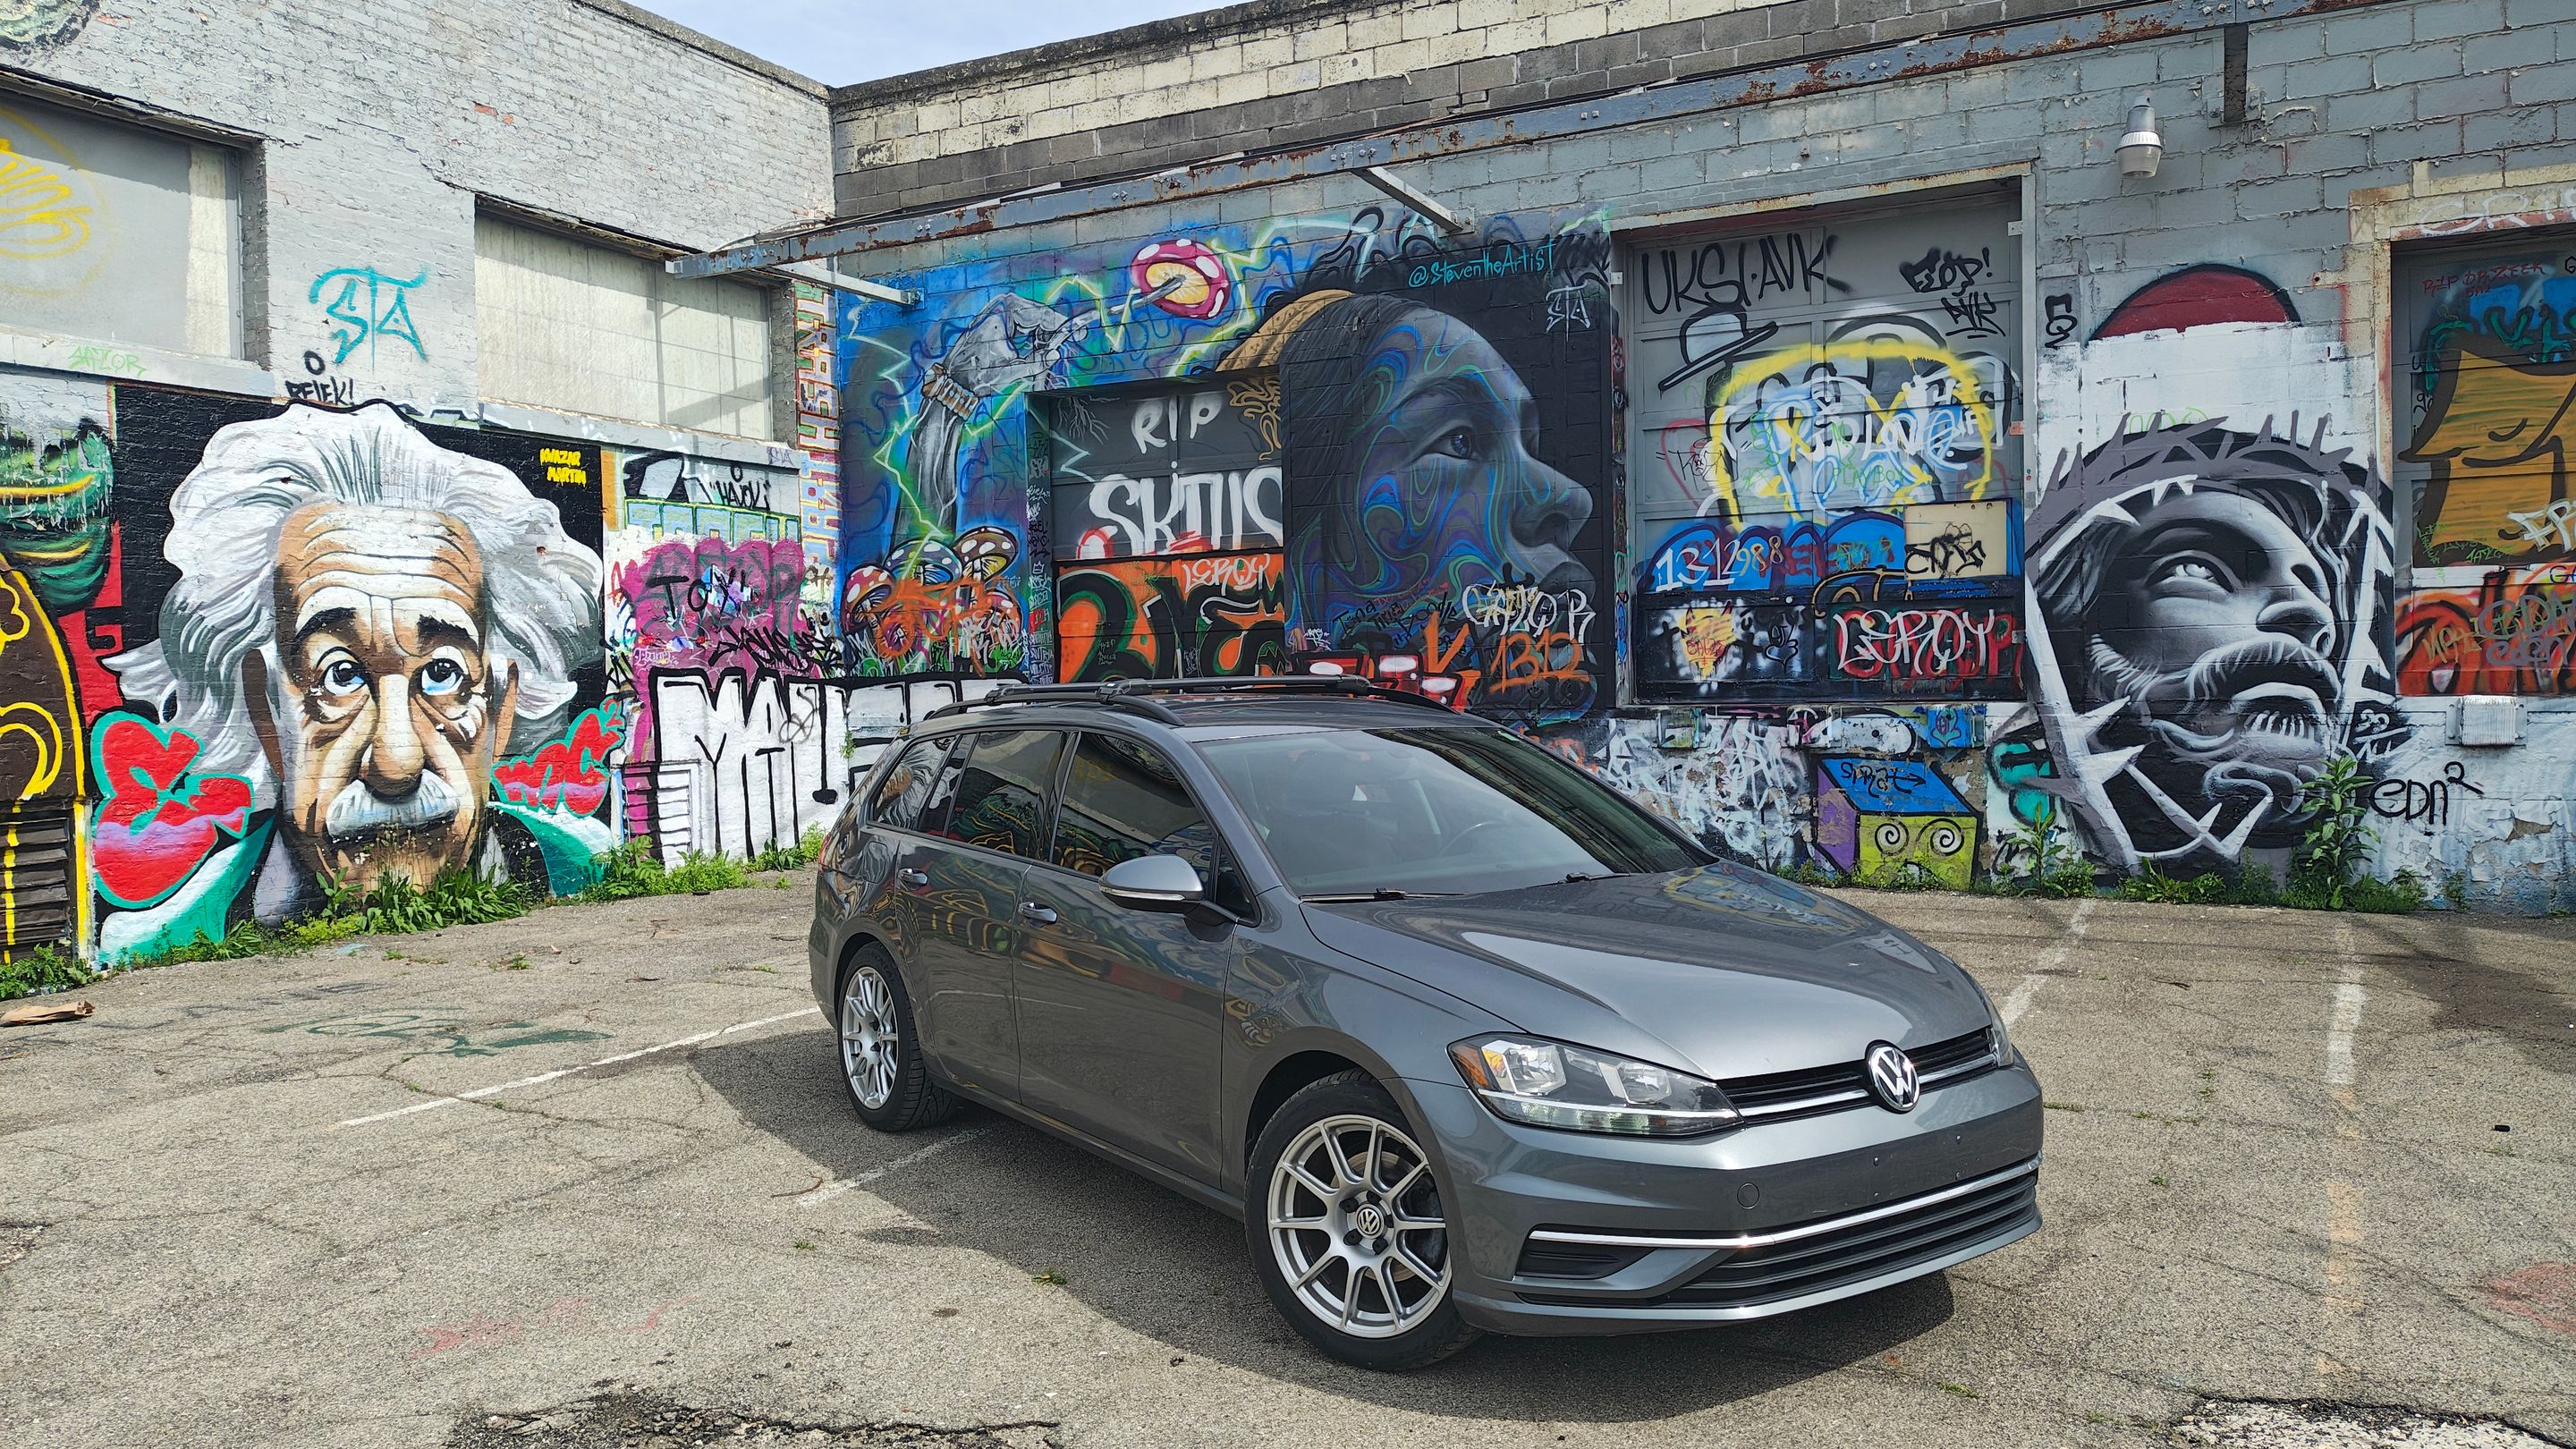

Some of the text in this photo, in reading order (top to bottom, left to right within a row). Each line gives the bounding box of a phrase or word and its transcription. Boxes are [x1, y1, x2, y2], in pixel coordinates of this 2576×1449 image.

[1409, 236, 1556, 287] @SteventheArtist
[309, 266, 430, 365] STA
[1546, 280, 1591, 340] STA
[1131, 393, 1224, 454] RIP
[547, 466, 587, 487] MARTIN
[1182, 553, 1271, 597] LEROY
[1490, 629, 1586, 693] 1312
[1833, 608, 1996, 676] LEROY
